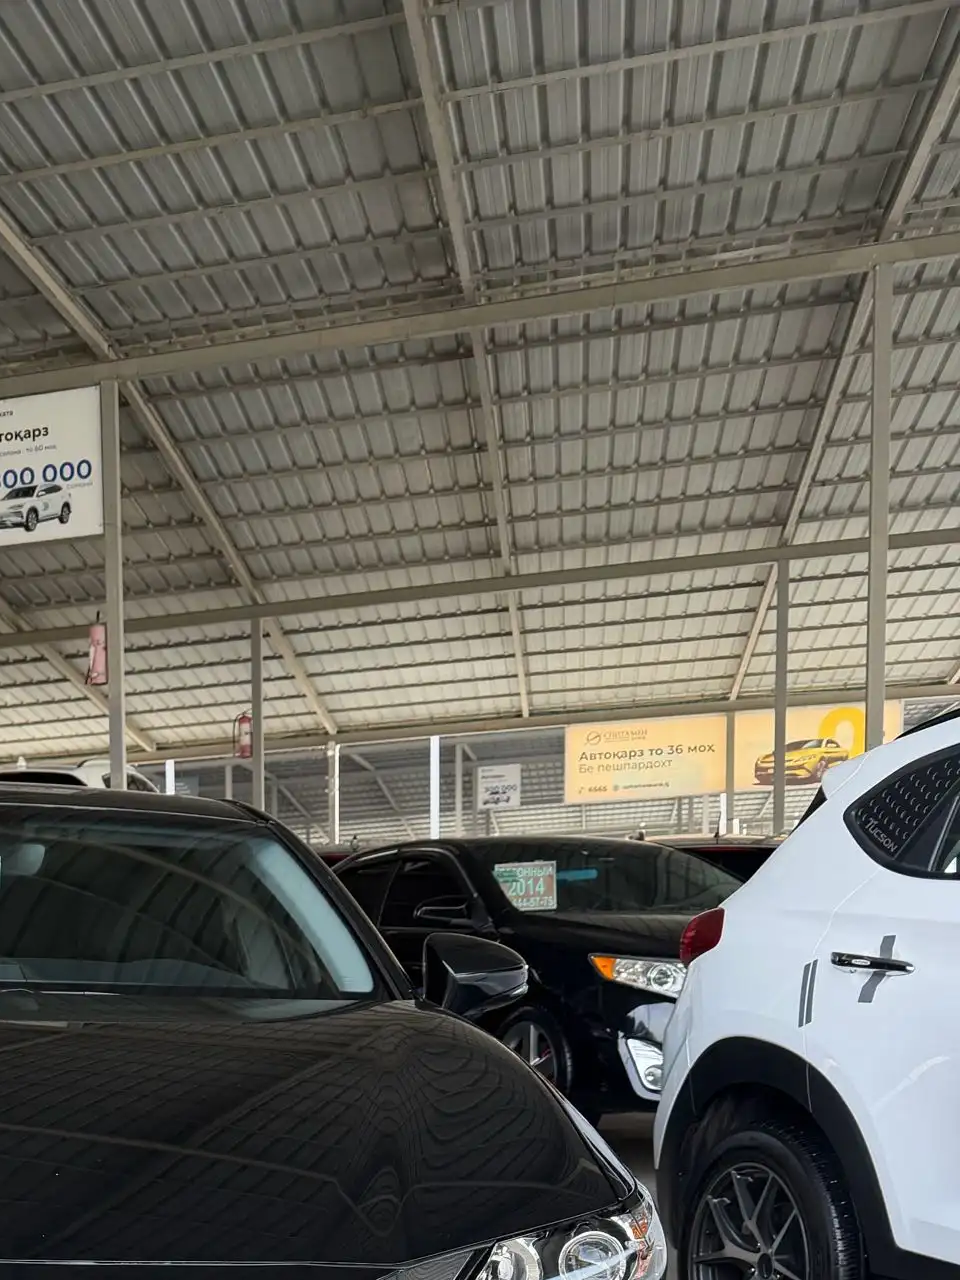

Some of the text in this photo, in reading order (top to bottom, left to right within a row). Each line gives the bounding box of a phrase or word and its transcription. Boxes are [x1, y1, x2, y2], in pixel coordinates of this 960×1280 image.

[42, 459, 93, 483] 000
[579, 743, 716, 762] Автоқарз то 36 моҳ
[578, 759, 673, 774] Бе пешпардохт
[509, 877, 545, 896] 2014
